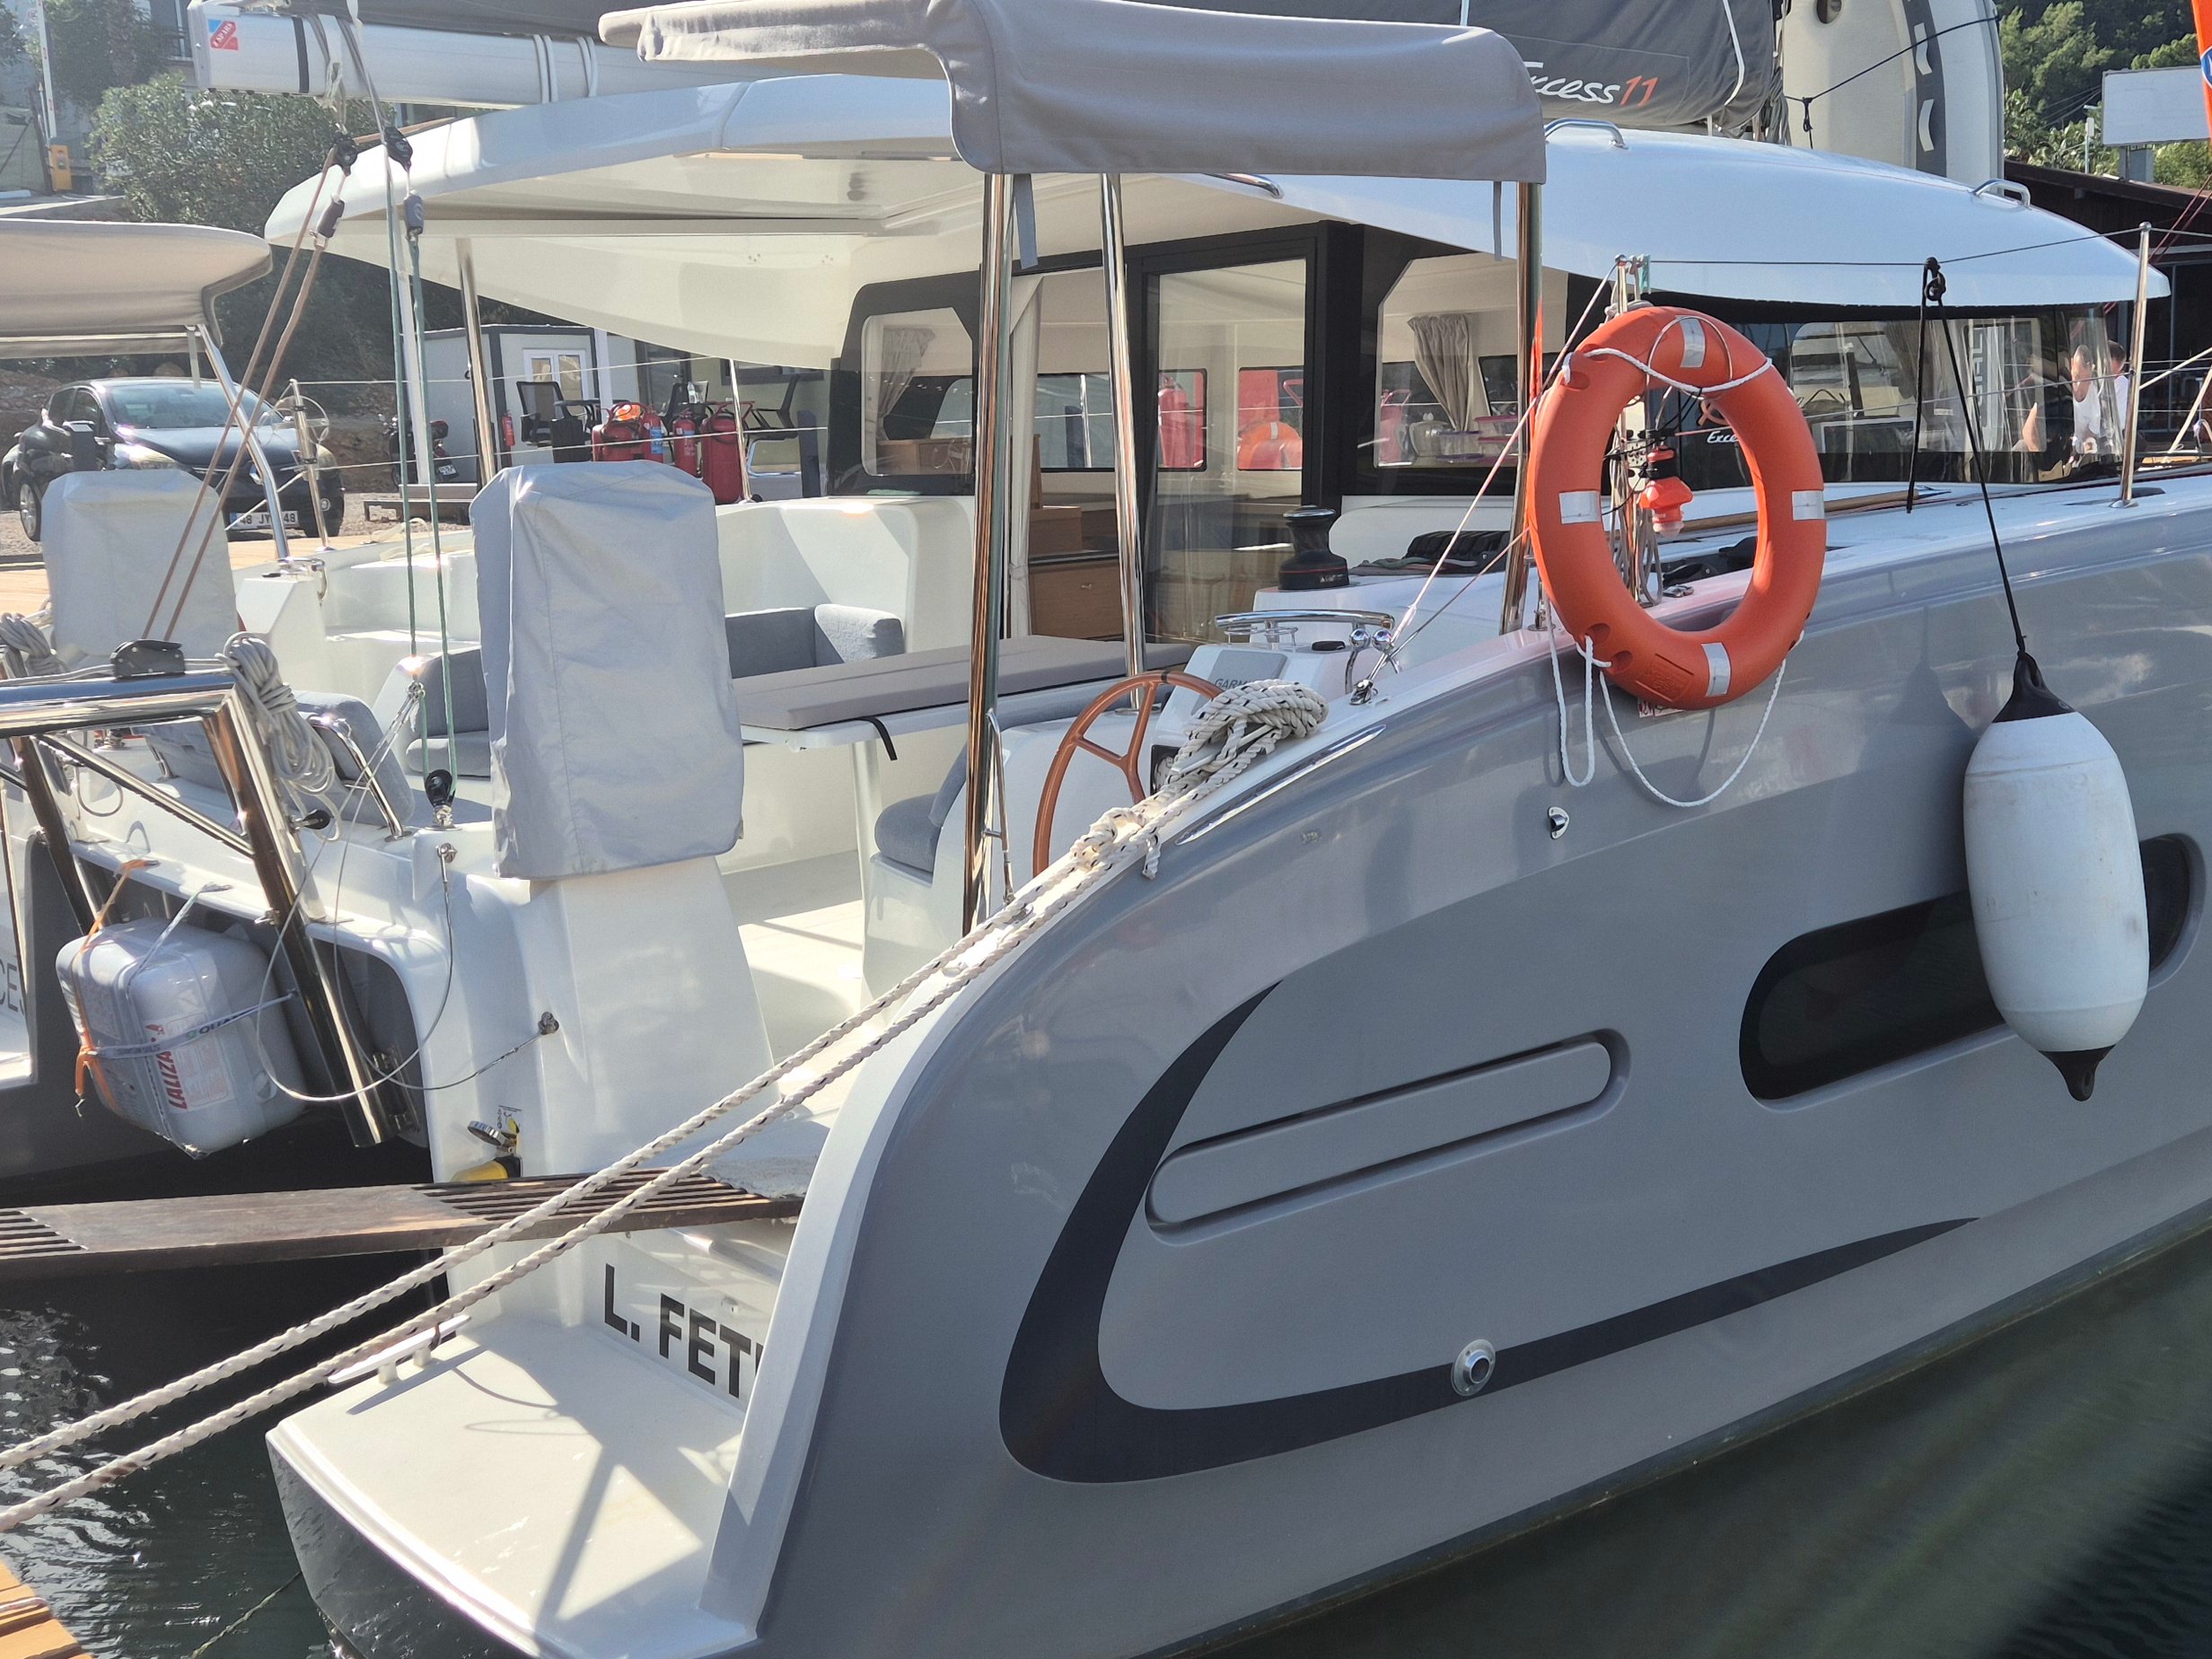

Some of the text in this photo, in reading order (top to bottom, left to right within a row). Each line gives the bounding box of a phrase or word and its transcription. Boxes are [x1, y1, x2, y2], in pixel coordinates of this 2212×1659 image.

[1707, 430, 1740, 443] Exce
[151, 1037, 188, 1110] LALIZA
[604, 1263, 765, 1400] L. FET
